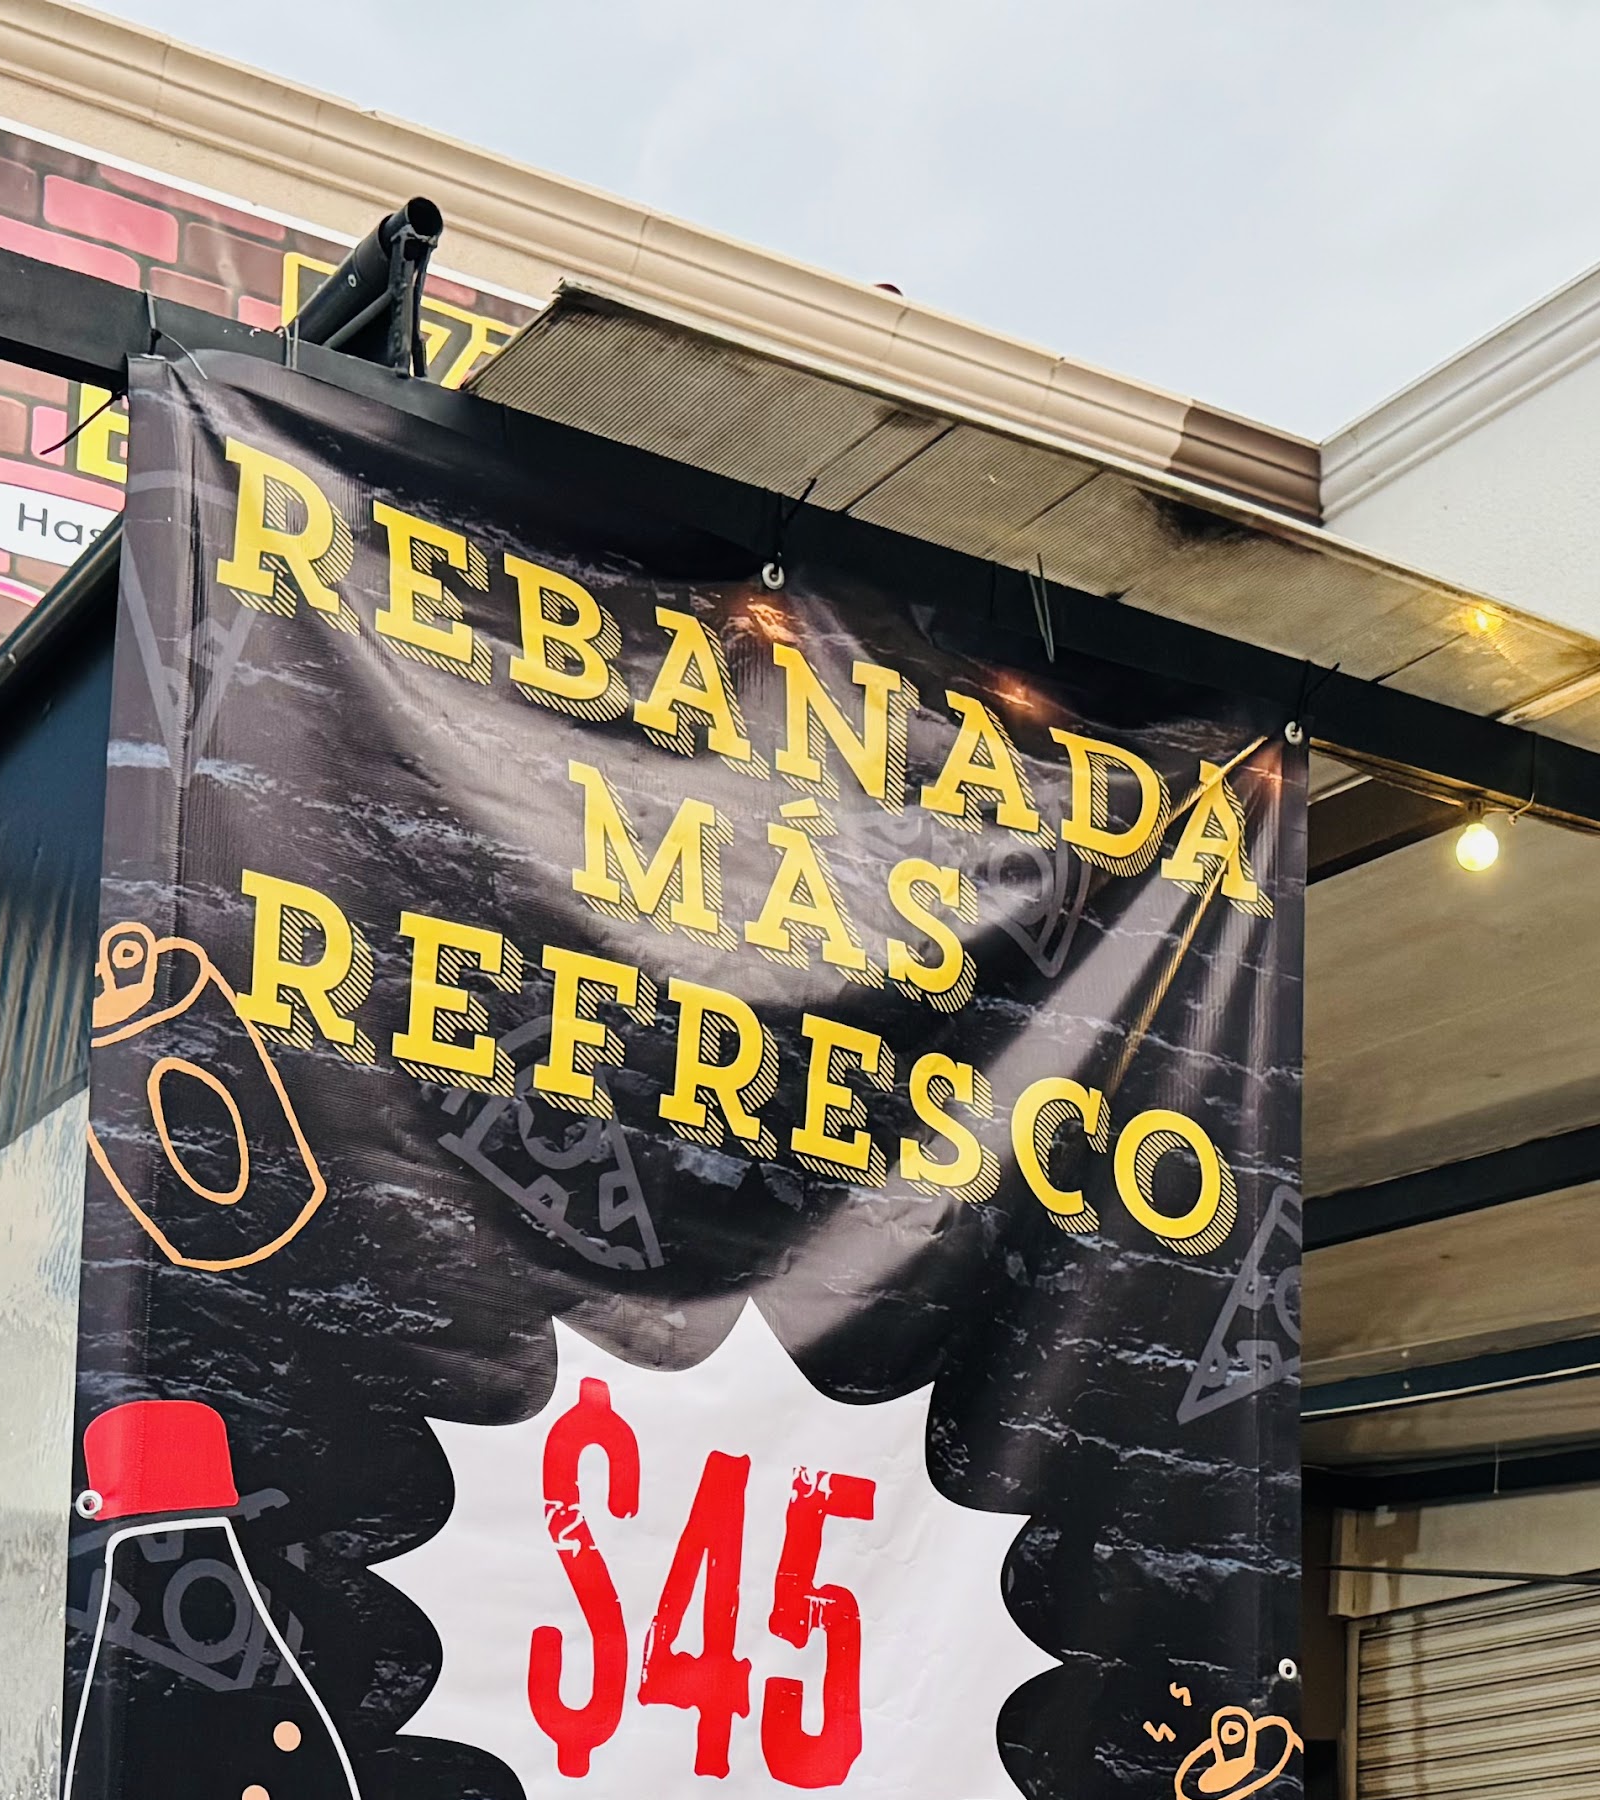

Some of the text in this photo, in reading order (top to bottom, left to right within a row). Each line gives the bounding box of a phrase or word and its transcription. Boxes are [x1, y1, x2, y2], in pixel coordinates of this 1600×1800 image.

[215, 436, 1272, 914] REBANADA
[234, 869, 1236, 1254] REFRESCO
[569, 758, 978, 1009] MÁS
[527, 1376, 876, 1789] $45
